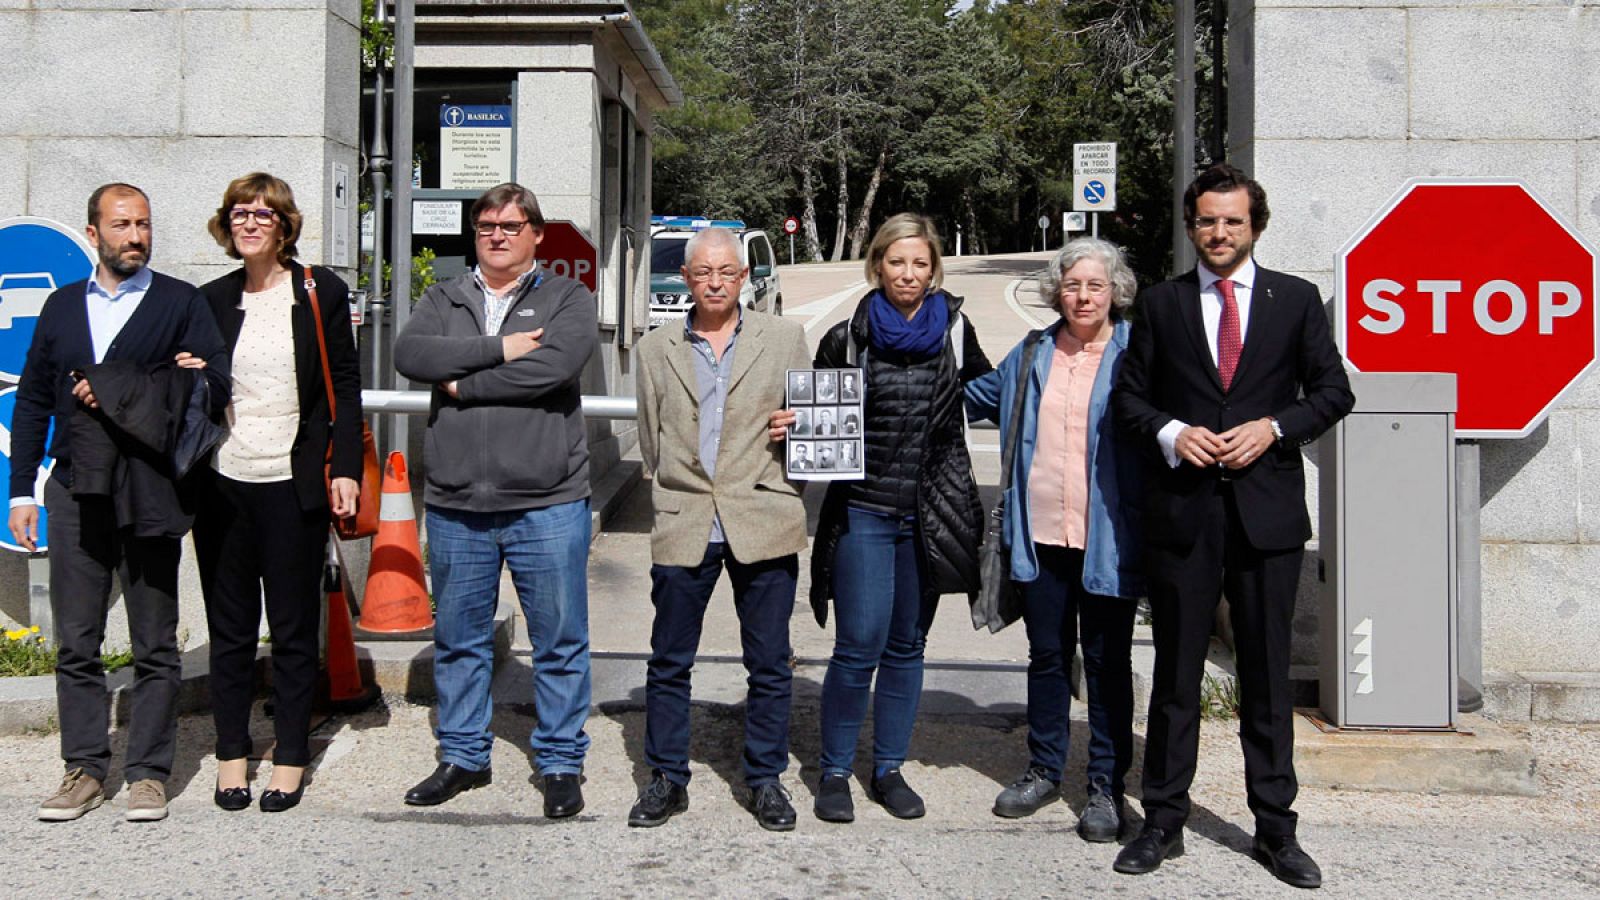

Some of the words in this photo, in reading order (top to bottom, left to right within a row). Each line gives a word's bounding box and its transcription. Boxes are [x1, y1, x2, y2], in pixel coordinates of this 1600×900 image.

[467, 113, 504, 121] BASILICA
[536, 258, 591, 281] TOP
[1358, 278, 1582, 335] STOP
